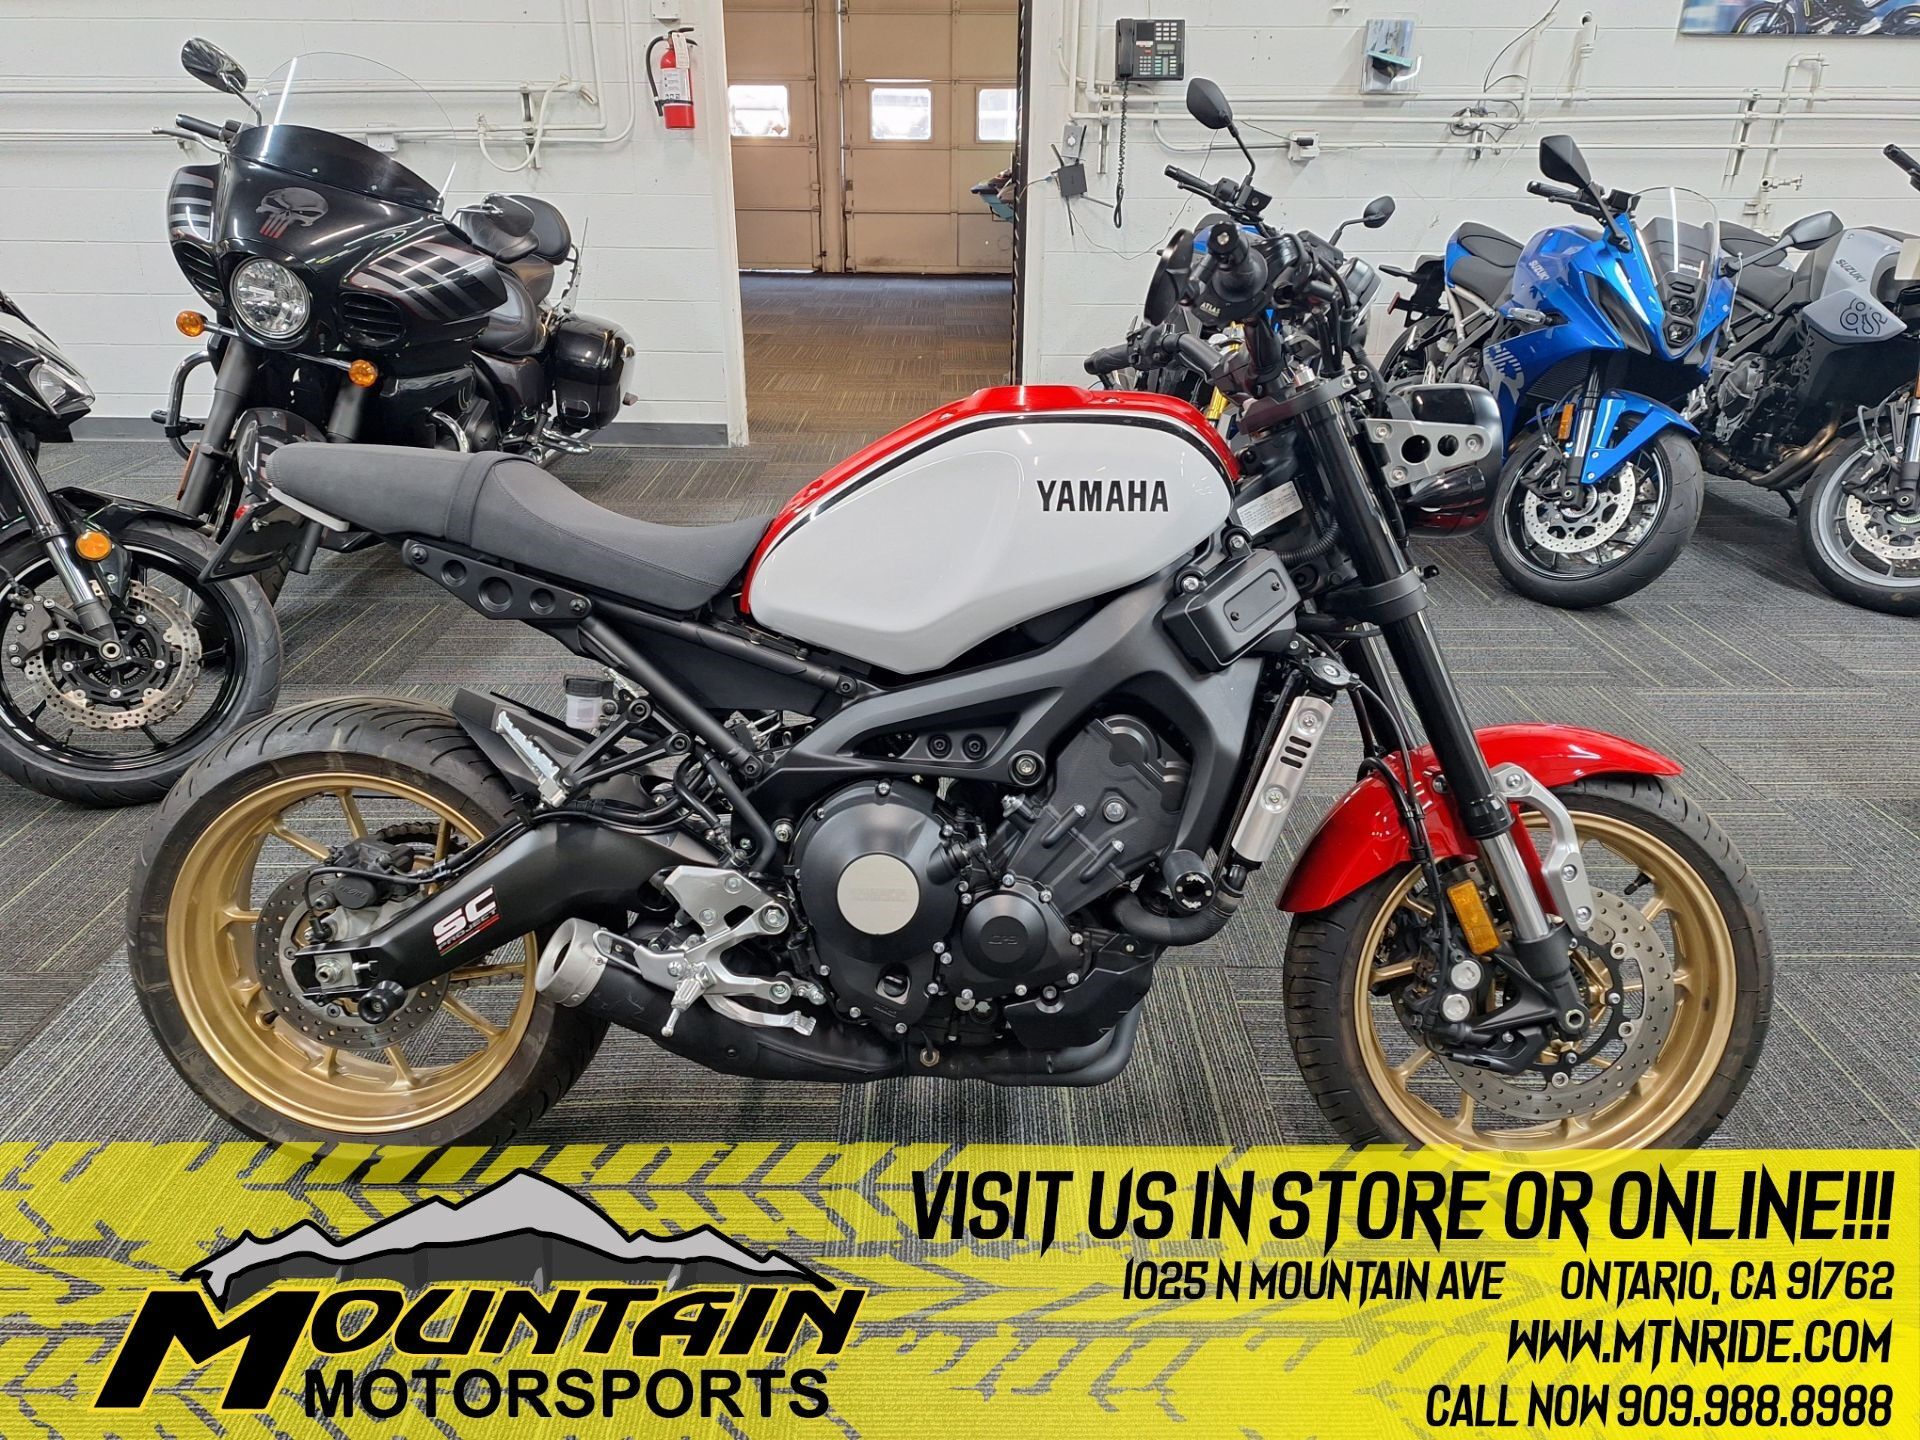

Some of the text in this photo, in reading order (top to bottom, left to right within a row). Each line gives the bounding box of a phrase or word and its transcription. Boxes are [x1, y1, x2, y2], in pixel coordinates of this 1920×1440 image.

[1836, 259, 1866, 283] SUZUKI
[1036, 480, 1169, 512] YAMAHA
[433, 887, 497, 946] SC
[438, 908, 497, 950] PROJECT
